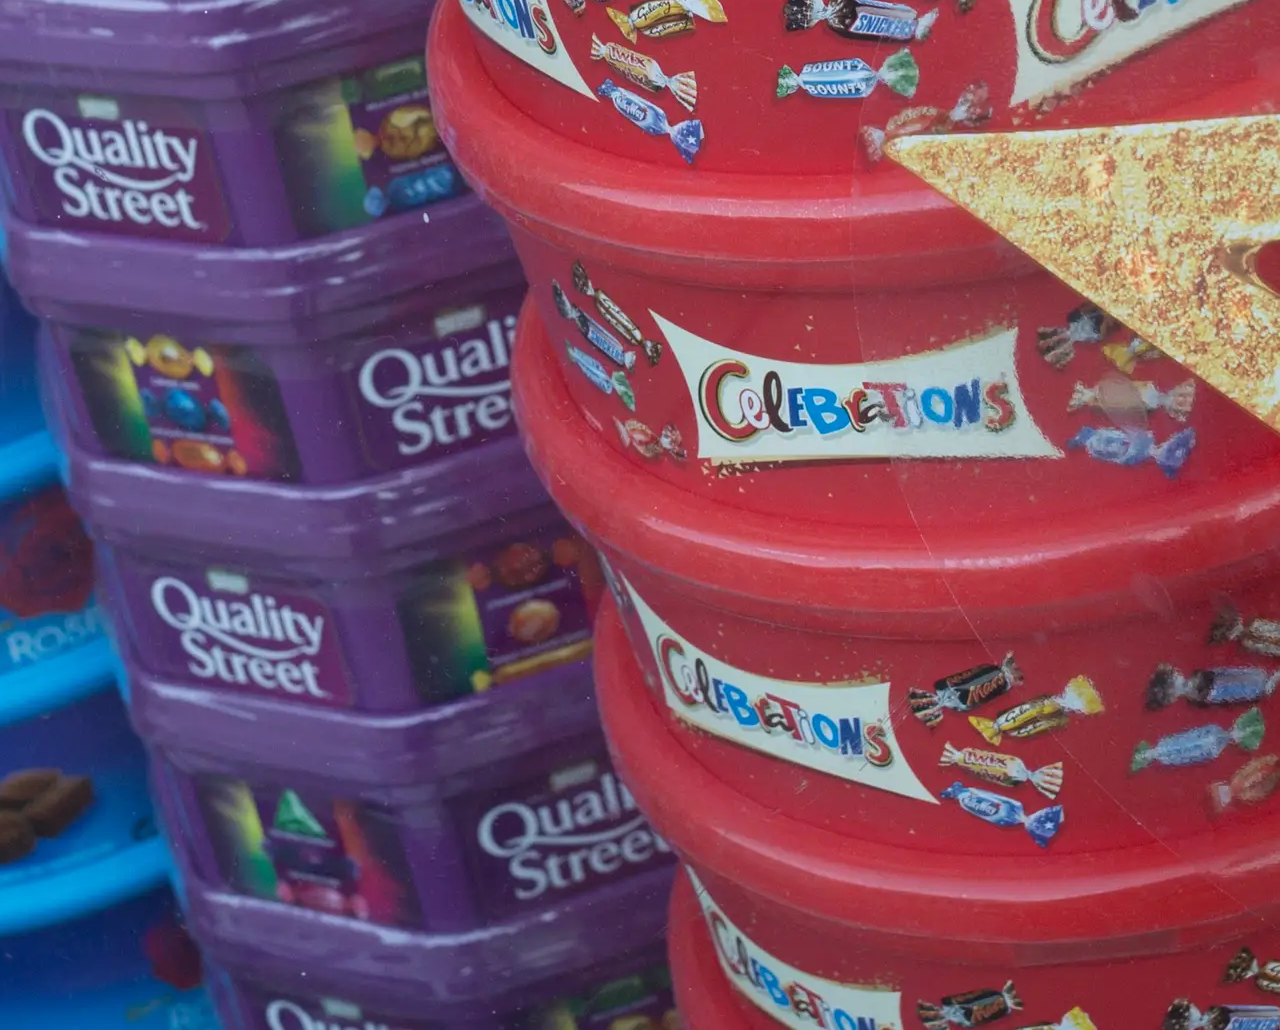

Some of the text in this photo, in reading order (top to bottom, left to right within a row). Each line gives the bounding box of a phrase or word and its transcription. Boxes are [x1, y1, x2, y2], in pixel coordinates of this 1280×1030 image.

[637, 0, 671, 20] Galaxy
[608, 45, 647, 68] Twix
[802, 58, 863, 74] BOUNTY
[806, 82, 867, 96] BOUNTY
[23, 108, 197, 190] Quality
[54, 167, 203, 230] Street
[359, 314, 518, 409] Quali
[392, 382, 516, 456] Stre
[151, 577, 324, 659] Quality
[181, 627, 328, 698] Street
[967, 672, 1006, 706] Mars
[963, 749, 1008, 767] Twix
[478, 773, 641, 857] Qual
[510, 828, 669, 900] Stree
